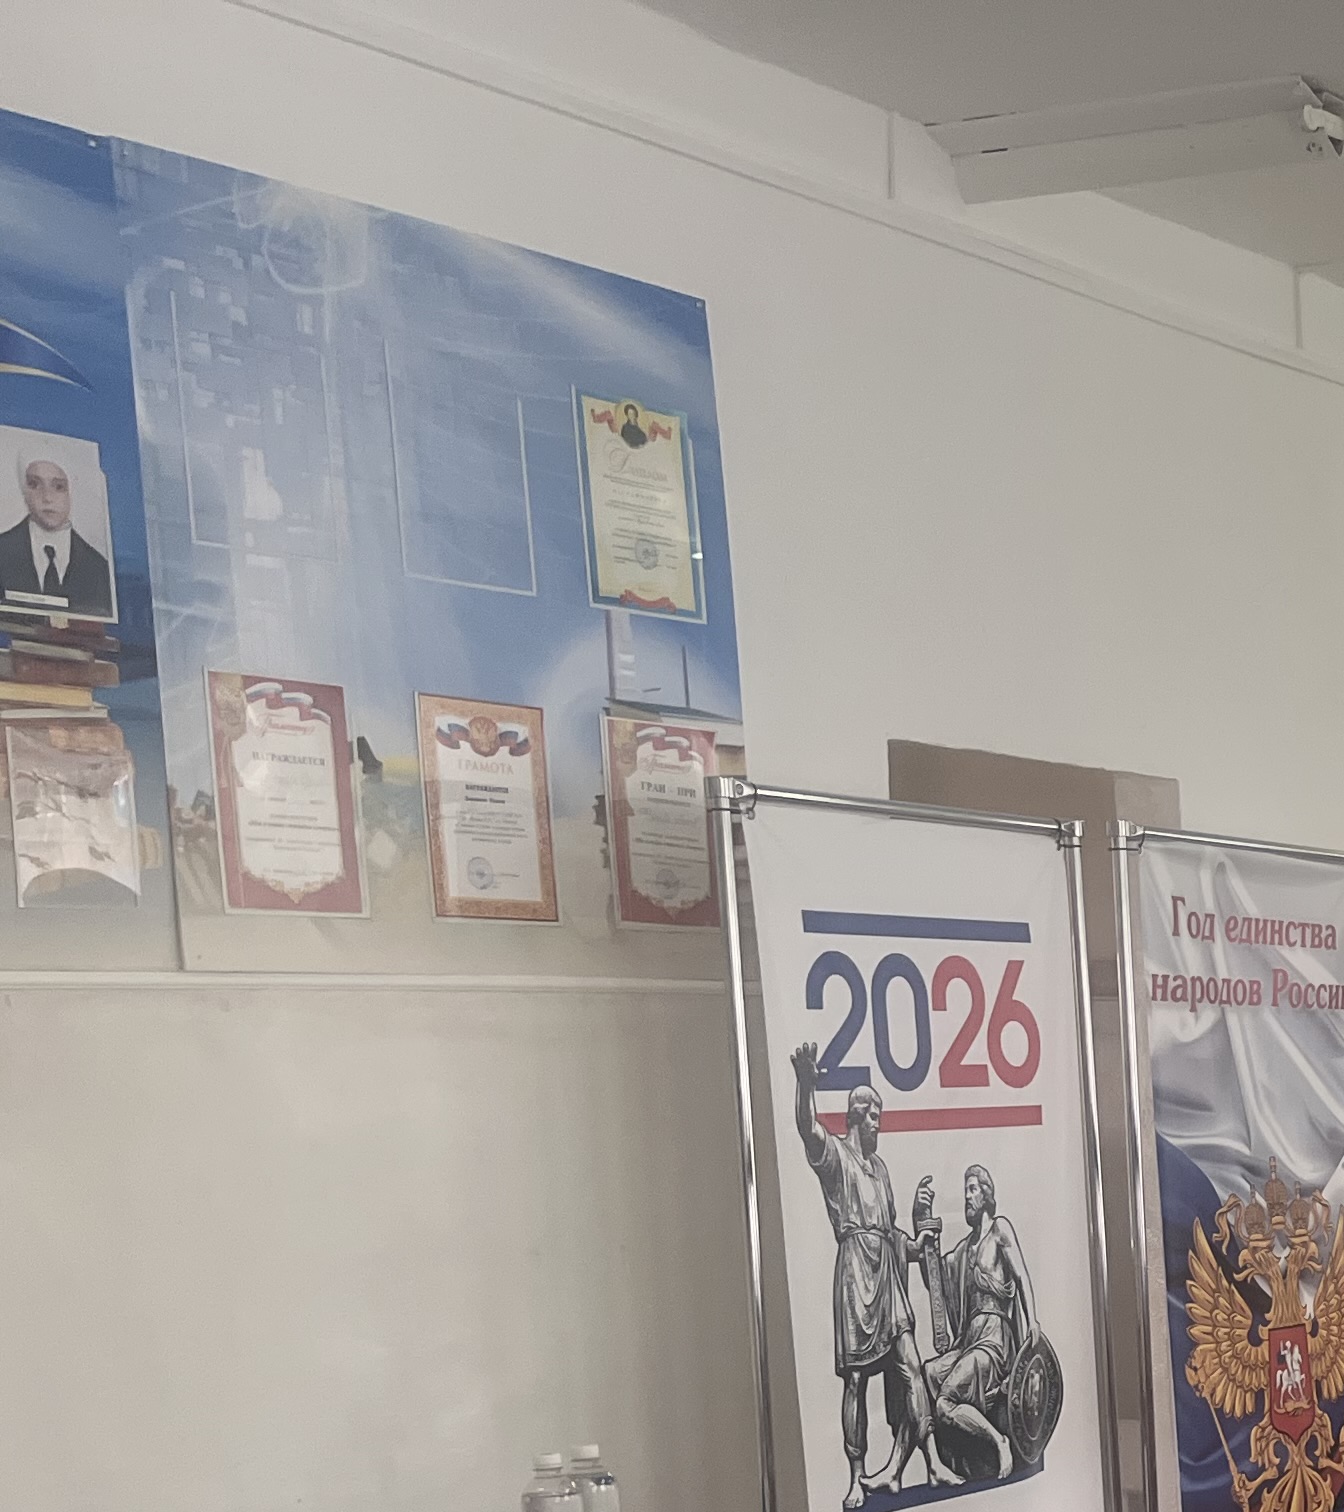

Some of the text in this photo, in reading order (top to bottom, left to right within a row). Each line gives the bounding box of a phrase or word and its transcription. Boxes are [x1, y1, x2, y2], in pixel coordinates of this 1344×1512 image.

[458, 759, 515, 775] ГРАМОТА
[640, 781, 666, 794] ГРАН
[677, 787, 697, 799] ПРИ
[1170, 896, 1338, 951] Год единства
[1151, 970, 1263, 1013] народов
[806, 951, 1042, 1092] 2026
